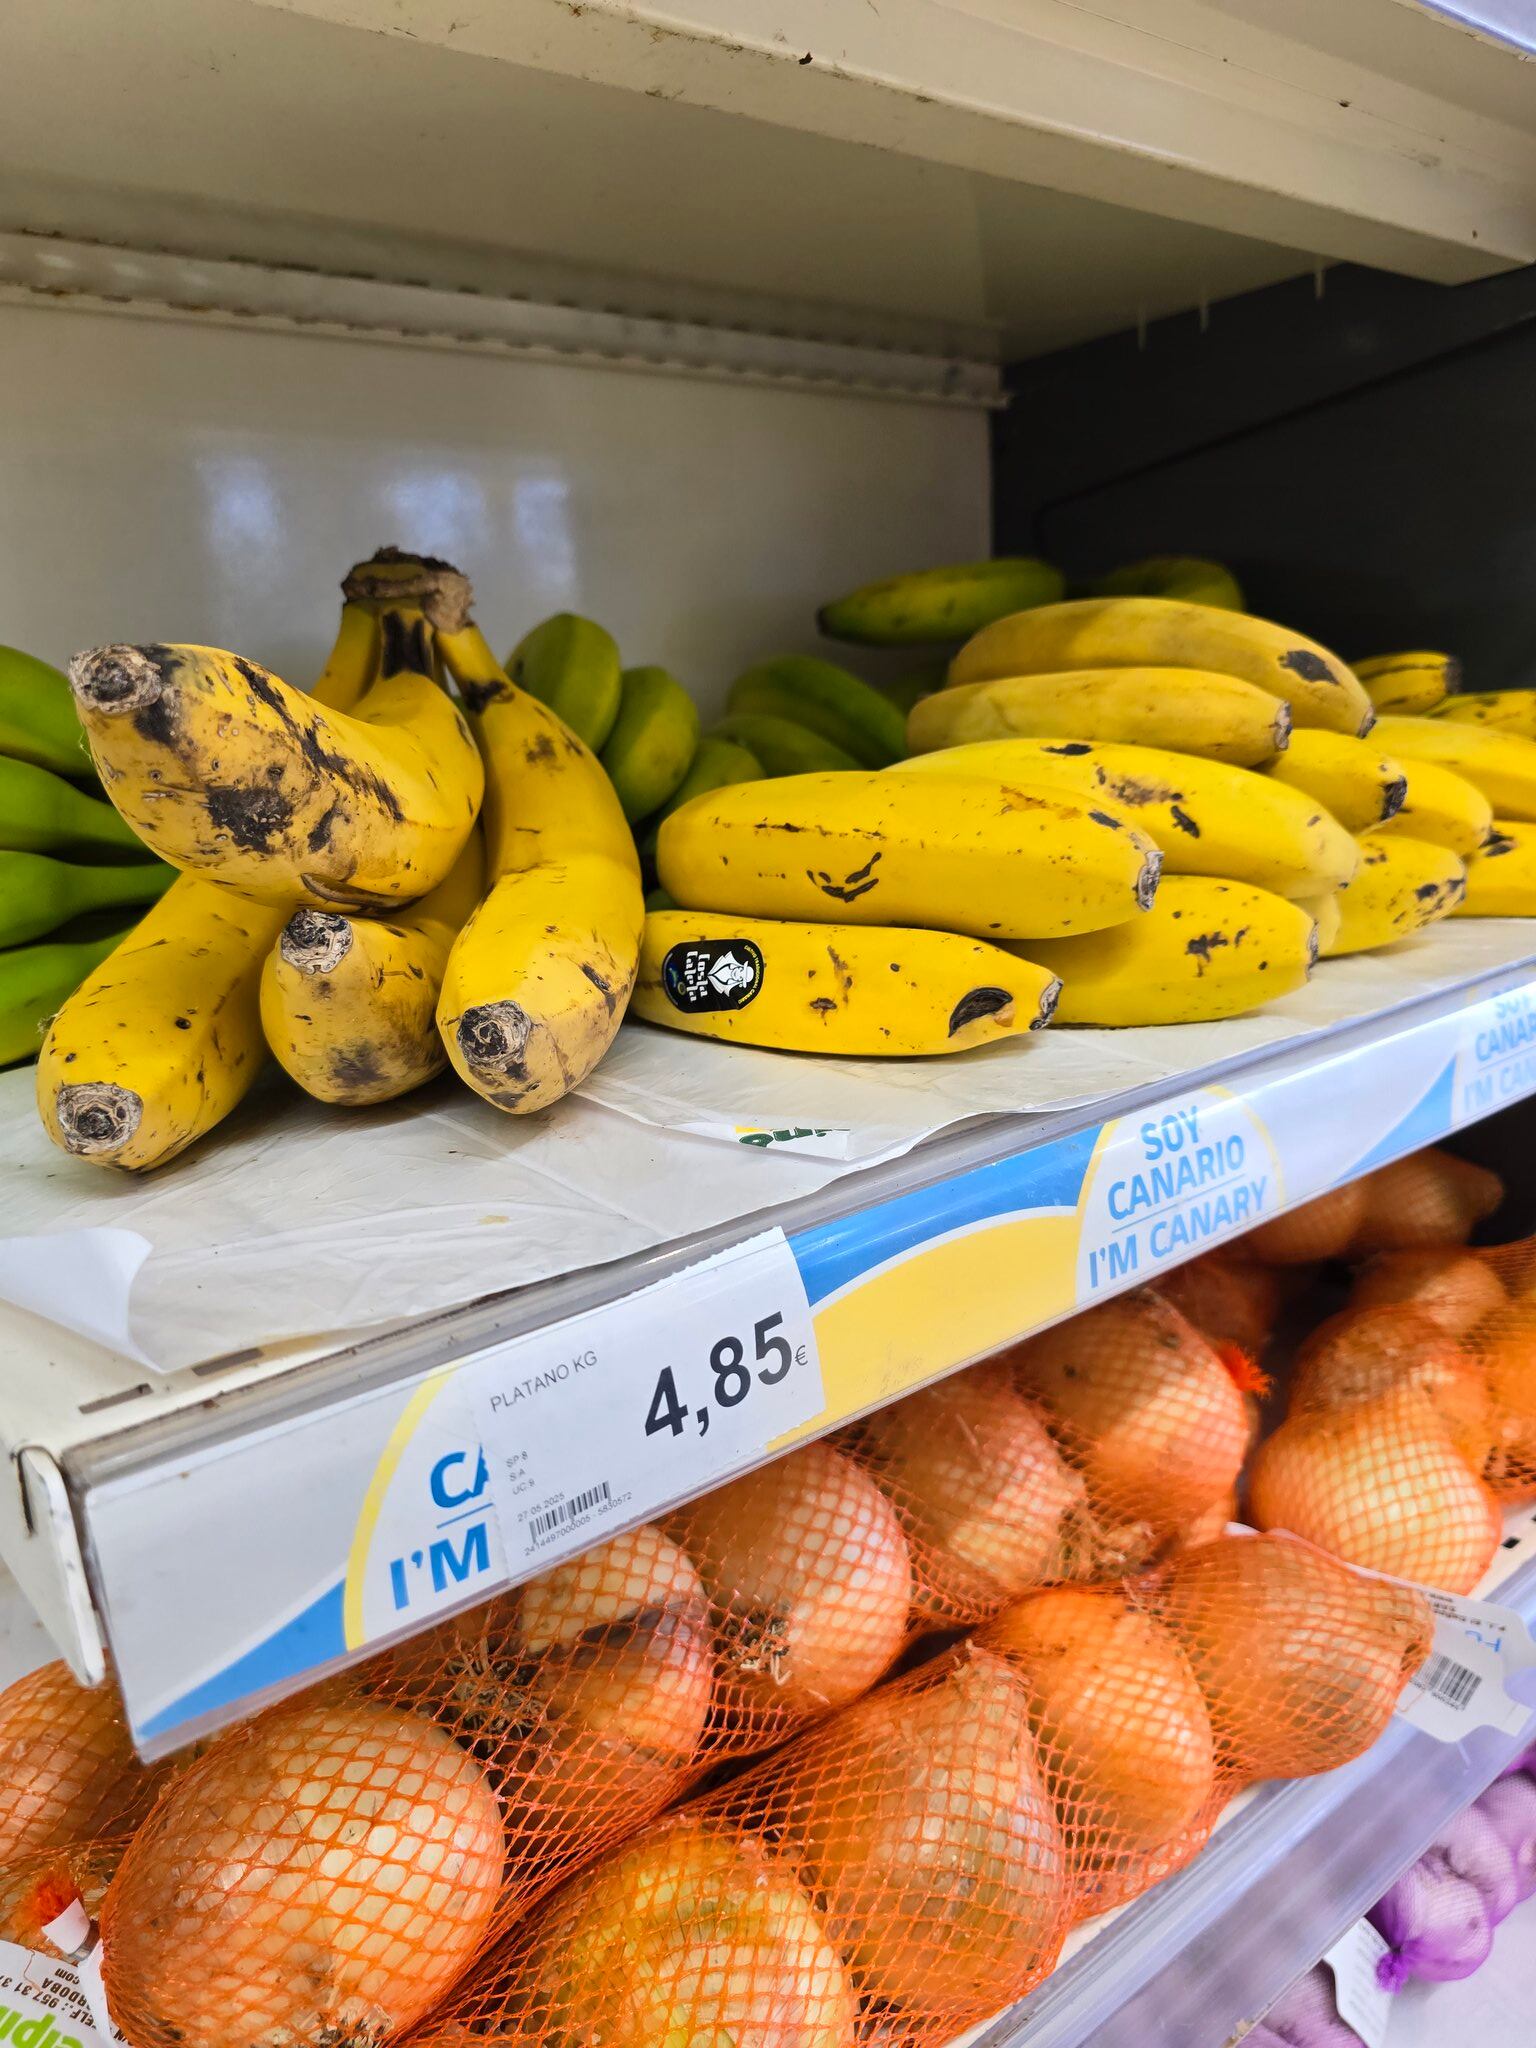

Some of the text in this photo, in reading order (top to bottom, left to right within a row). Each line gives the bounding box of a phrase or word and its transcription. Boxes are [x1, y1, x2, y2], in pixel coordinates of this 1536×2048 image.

[1140, 1105, 1199, 1161] SOY
[1107, 1135, 1245, 1220] CANARIO
[1089, 1175, 1267, 1288] I'M CANARY
[489, 1349, 598, 1413] PLATANO KG
[390, 1522, 490, 1611] I'M
[14, 1982, 32, 1996] 31
[32, 1991, 60, 2008] 957
[41, 1977, 91, 2010] RDOBA
